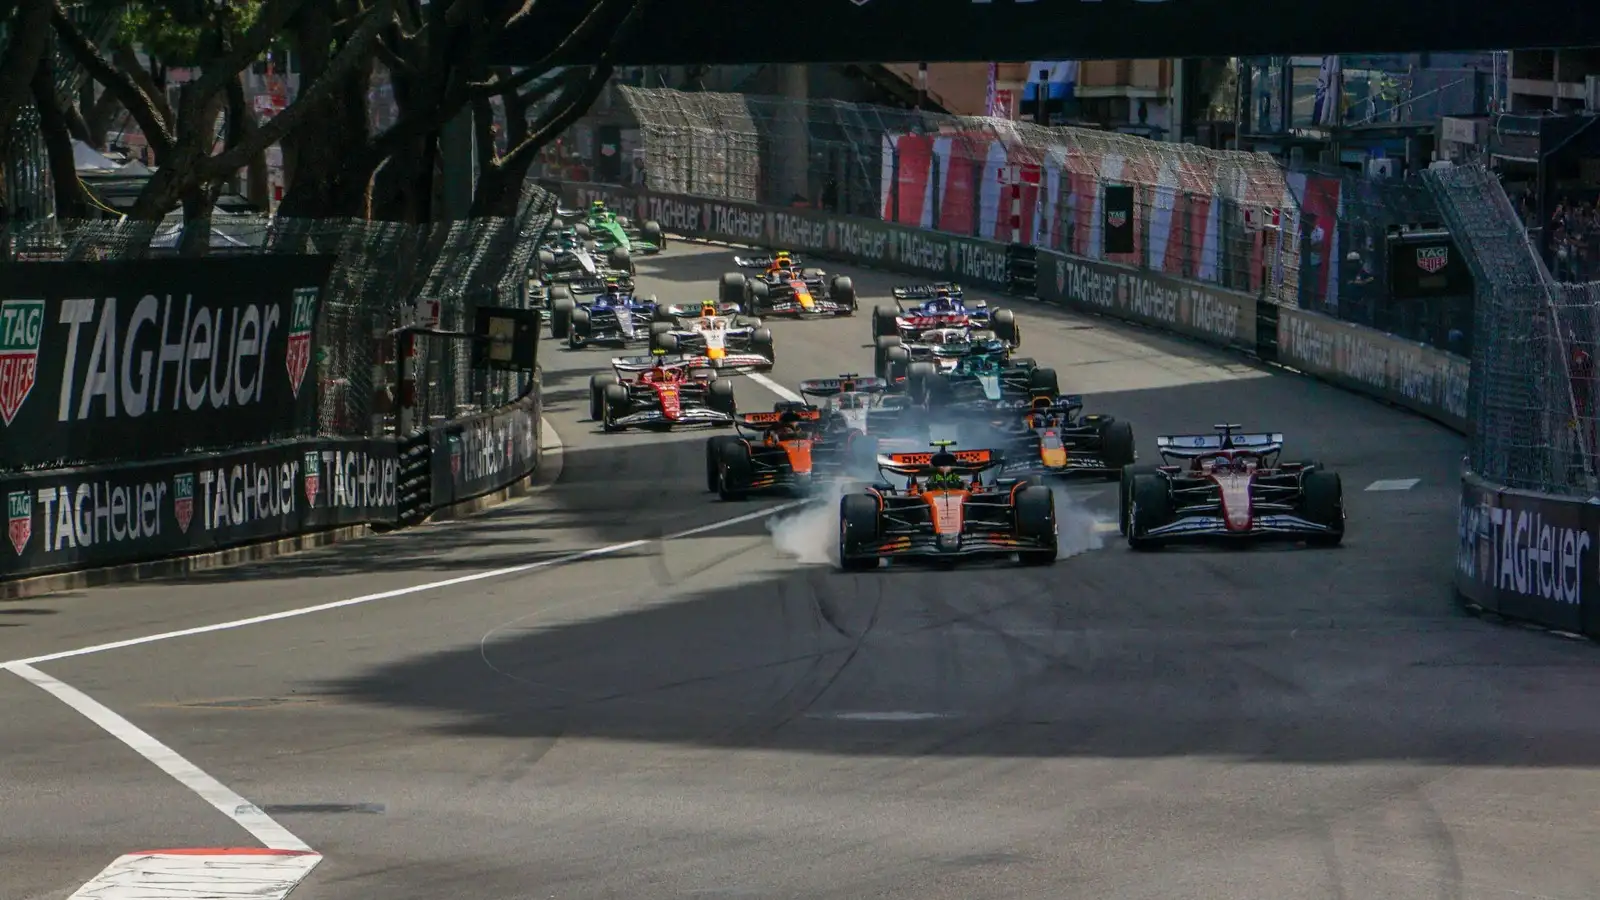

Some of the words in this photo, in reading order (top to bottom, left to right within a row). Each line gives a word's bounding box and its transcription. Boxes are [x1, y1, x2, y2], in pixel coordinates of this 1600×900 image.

[714, 205, 765, 239] TAGHeuer
[1420, 248, 1445, 258] TAG
[1066, 262, 1117, 307] TAGHeuer
[1129, 276, 1179, 322] TAGHeuer
[3, 307, 40, 346] TAG
[58, 293, 280, 422] TAGHeuer
[200, 460, 300, 530] TAGHeuer
[322, 450, 400, 508] TAGHeuer
[11, 495, 30, 516] TAG
[37, 480, 167, 552] TAGHeuer
[1490, 507, 1590, 605] TAGHeuer
